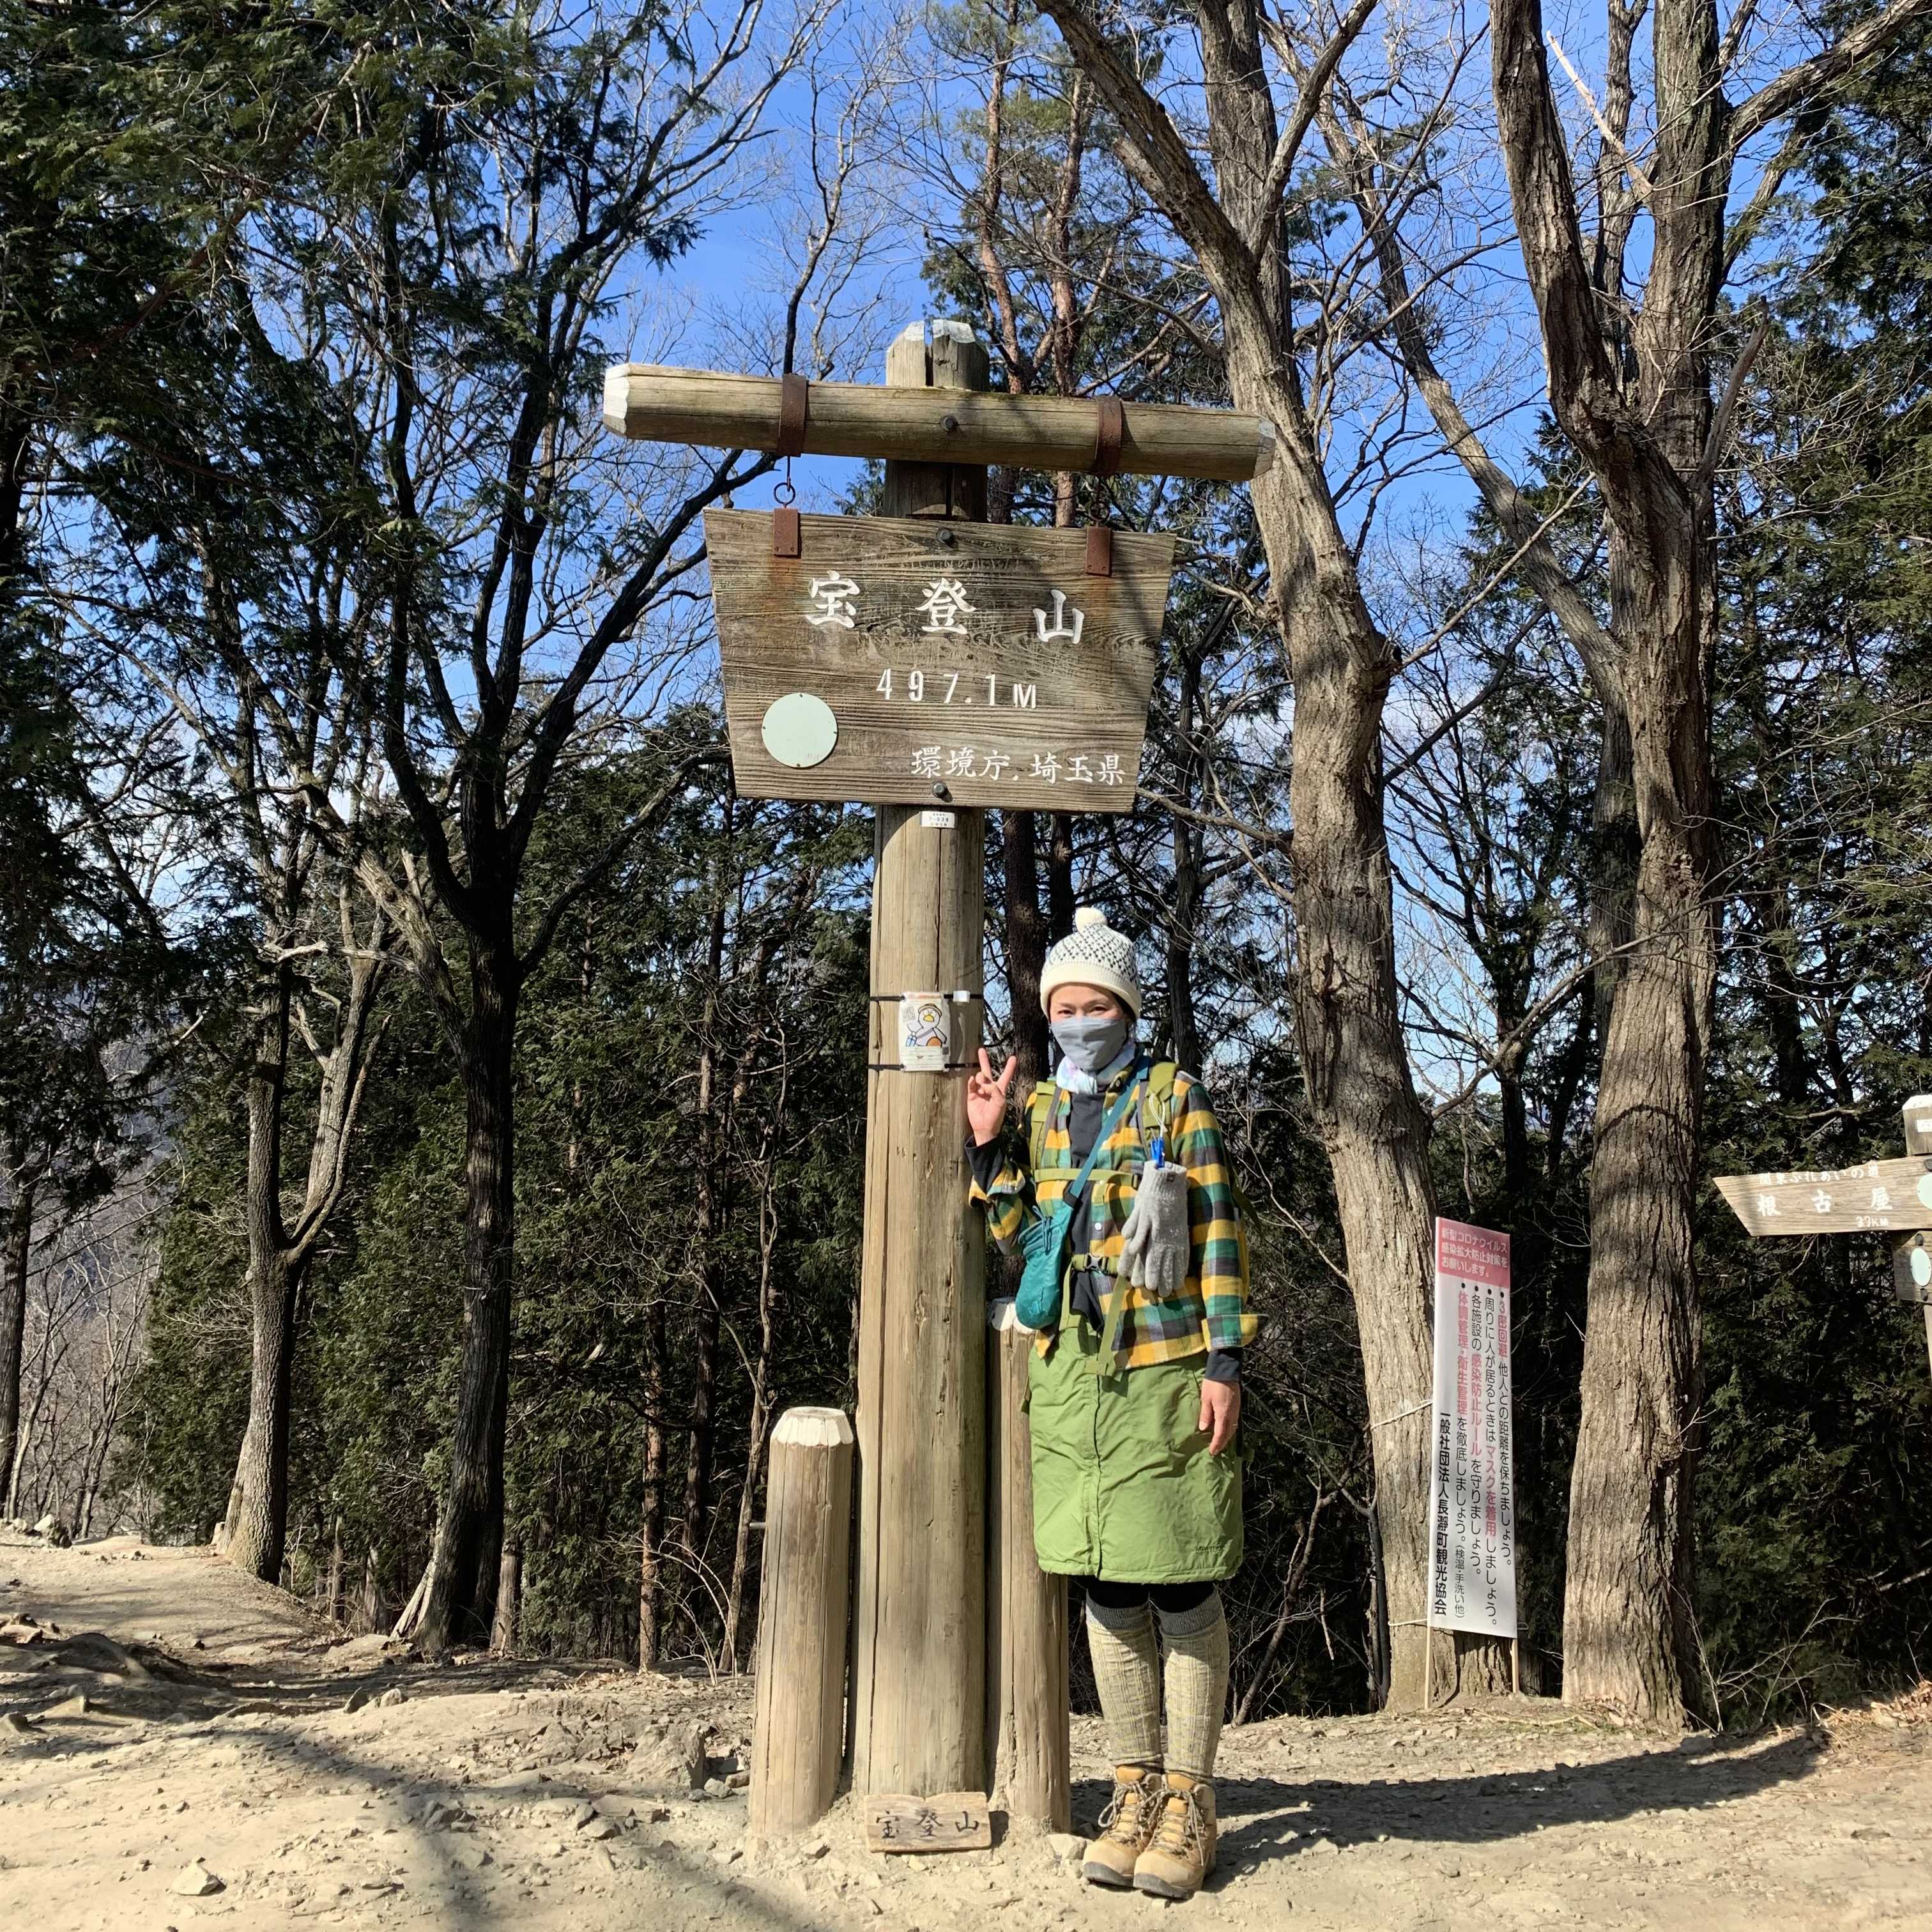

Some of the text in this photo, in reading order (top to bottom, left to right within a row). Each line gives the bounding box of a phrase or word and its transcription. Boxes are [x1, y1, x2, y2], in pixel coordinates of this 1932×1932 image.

[806, 569, 1085, 645] 宝登山
[1758, 1186, 1892, 1217] 根古屋
[1441, 1227, 1508, 1254] 新型コロナウイルス
[1441, 1242, 1508, 1268] 感染拡大防止対策を
[1441, 1257, 1489, 1278] お願いします。
[1434, 1411, 1452, 1616] 一般社団法人長瀞町観光協会
[876, 1810, 979, 1839] 宝登山
